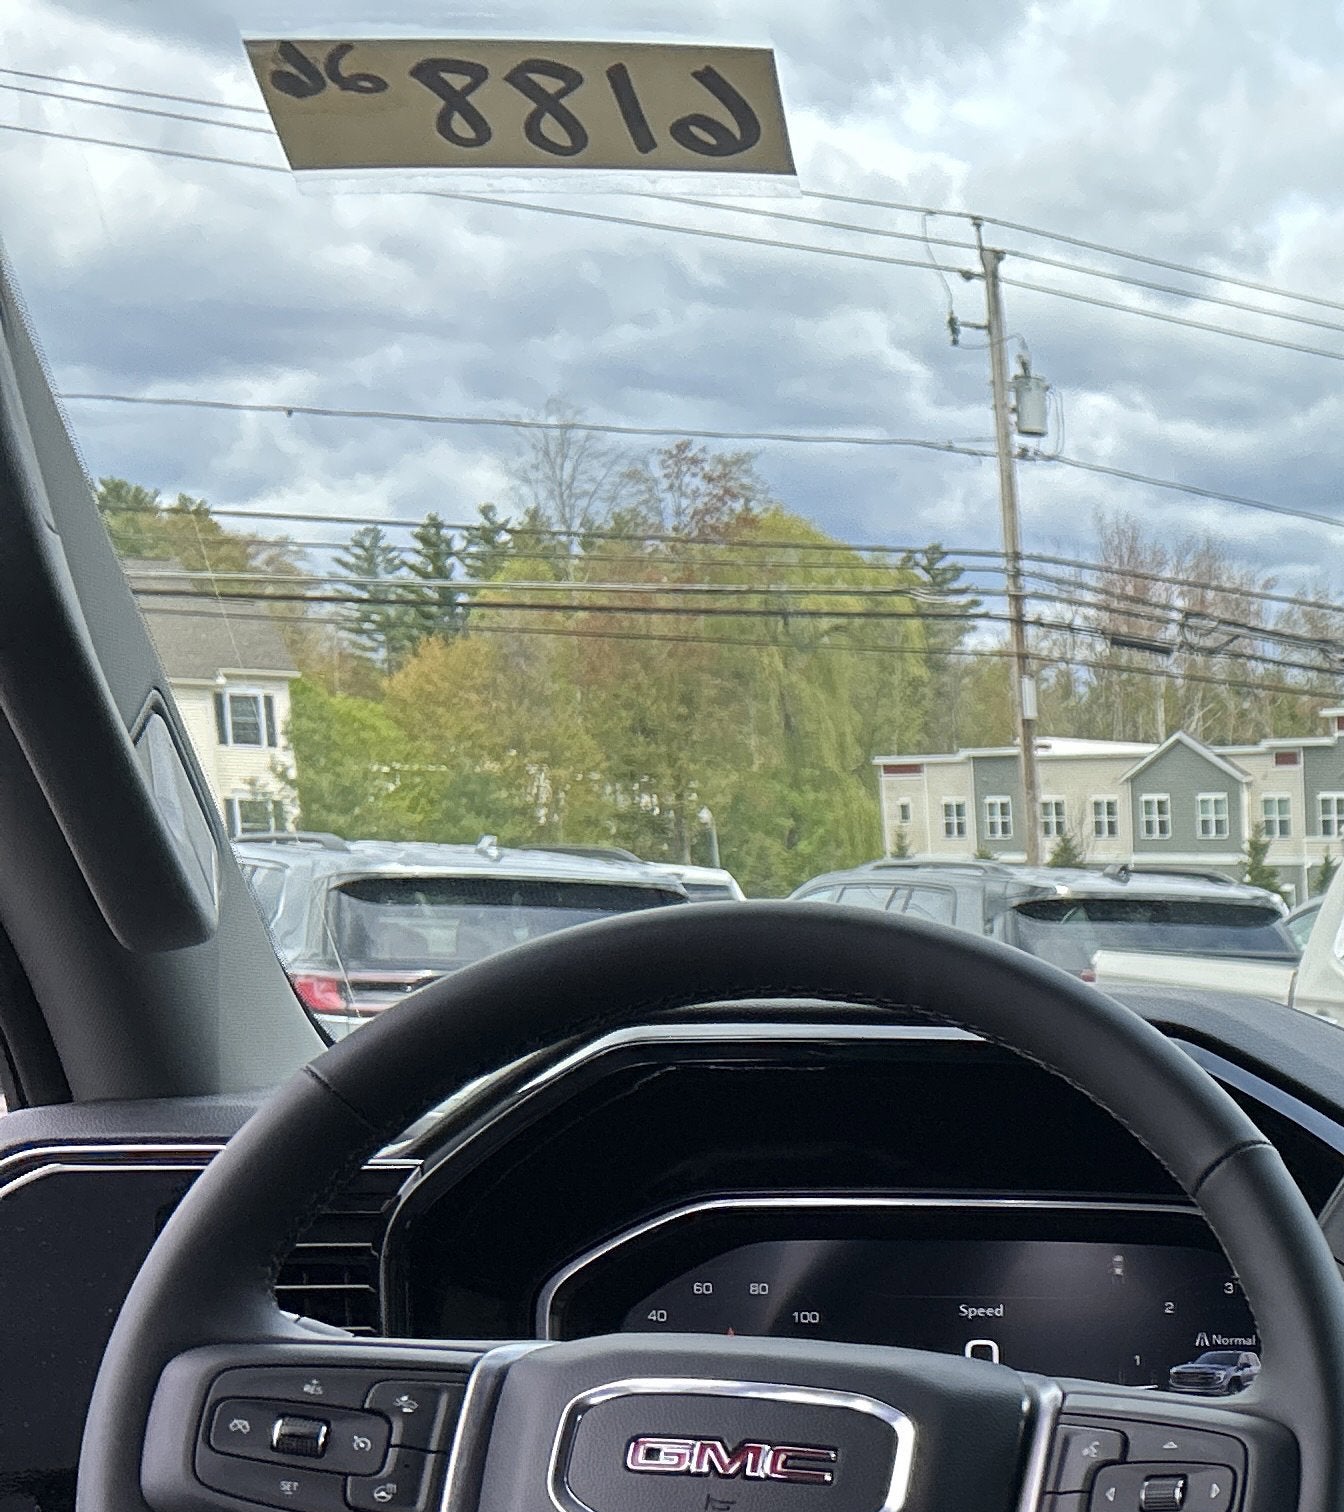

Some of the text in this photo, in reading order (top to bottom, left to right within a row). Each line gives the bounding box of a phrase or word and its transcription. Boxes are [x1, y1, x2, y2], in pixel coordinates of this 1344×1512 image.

[692, 1282, 714, 1295] 60
[748, 1282, 769, 1295] 80
[1223, 1282, 1234, 1296] 3
[958, 1302, 1004, 1321] Speed
[1163, 1302, 1175, 1315] 2
[647, 1310, 668, 1323] 40
[792, 1311, 820, 1324] 100
[1211, 1333, 1257, 1348] Normal
[625, 1436, 839, 1485] GMC
